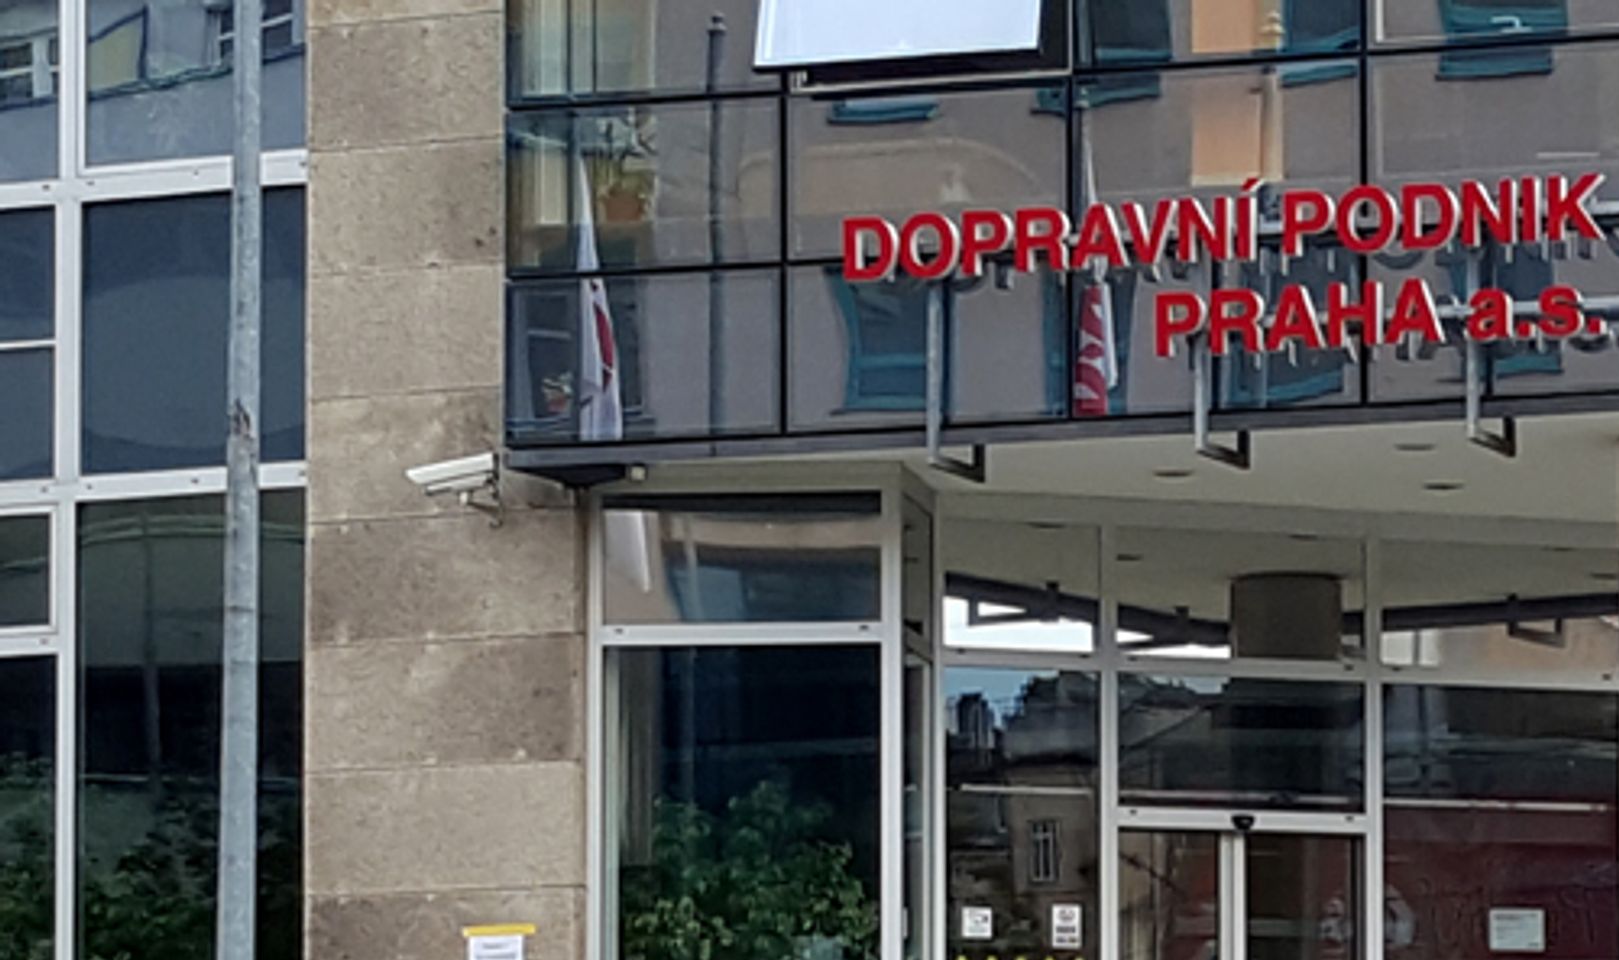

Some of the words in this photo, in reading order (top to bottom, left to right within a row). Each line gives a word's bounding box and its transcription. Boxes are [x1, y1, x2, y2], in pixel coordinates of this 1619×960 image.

[842, 178, 1264, 281] DOPRAVNÍ
[1281, 173, 1605, 258] PODNIK
[1155, 277, 1446, 358] PRAHA
[1465, 286, 1608, 342] a.s.
